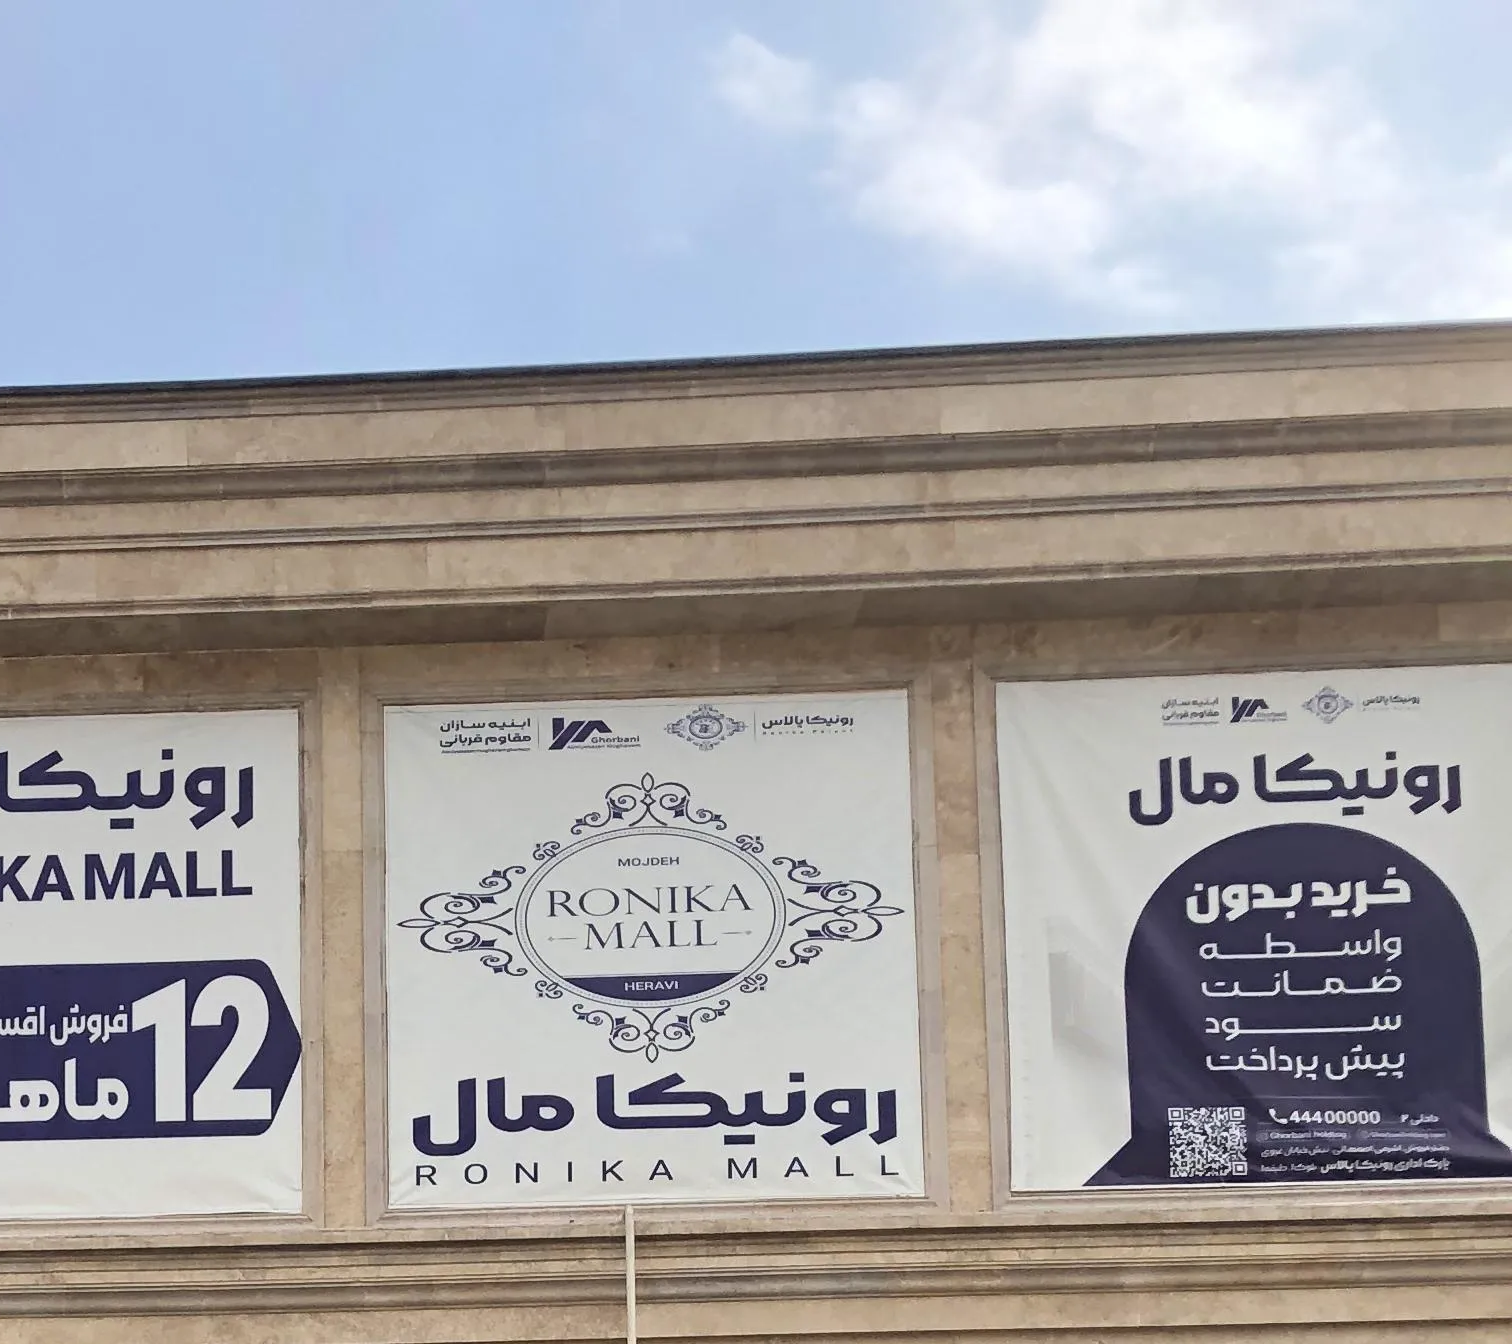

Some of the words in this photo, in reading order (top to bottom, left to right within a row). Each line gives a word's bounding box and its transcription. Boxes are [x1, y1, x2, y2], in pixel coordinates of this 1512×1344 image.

[439, 718, 486, 733] سازان
[487, 717, 531, 729] ابنیه
[805, 714, 854, 727] رونیکا
[439, 733, 483, 748] قربانی
[484, 732, 532, 746] مقاوم
[590, 735, 640, 744] Ghorbani
[1128, 755, 1240, 826] مال
[1253, 750, 1462, 816] رونیکا
[84, 848, 254, 901] MALL
[617, 855, 681, 868] MOJDEH
[546, 882, 755, 918] RONIKA
[1185, 880, 1304, 925] بدون
[1310, 866, 1413, 919] خرید
[584, 918, 719, 951] MALL
[1198, 928, 1403, 962] واسطه
[624, 980, 680, 992] HERAVI
[1200, 967, 1403, 998] ضمانت
[49, 1003, 129, 1047] فروش
[1204, 1014, 1403, 1042] سود
[131, 973, 273, 1124] 12
[1205, 1045, 1320, 1081] پرداخت
[1324, 1043, 1406, 1081] پیش
[411, 1075, 575, 1157] مال
[596, 1071, 898, 1146] رونیکا
[1289, 1109, 1381, 1125] 44400000
[415, 1157, 675, 1187] RONIKA
[727, 1154, 900, 1180] MALL
